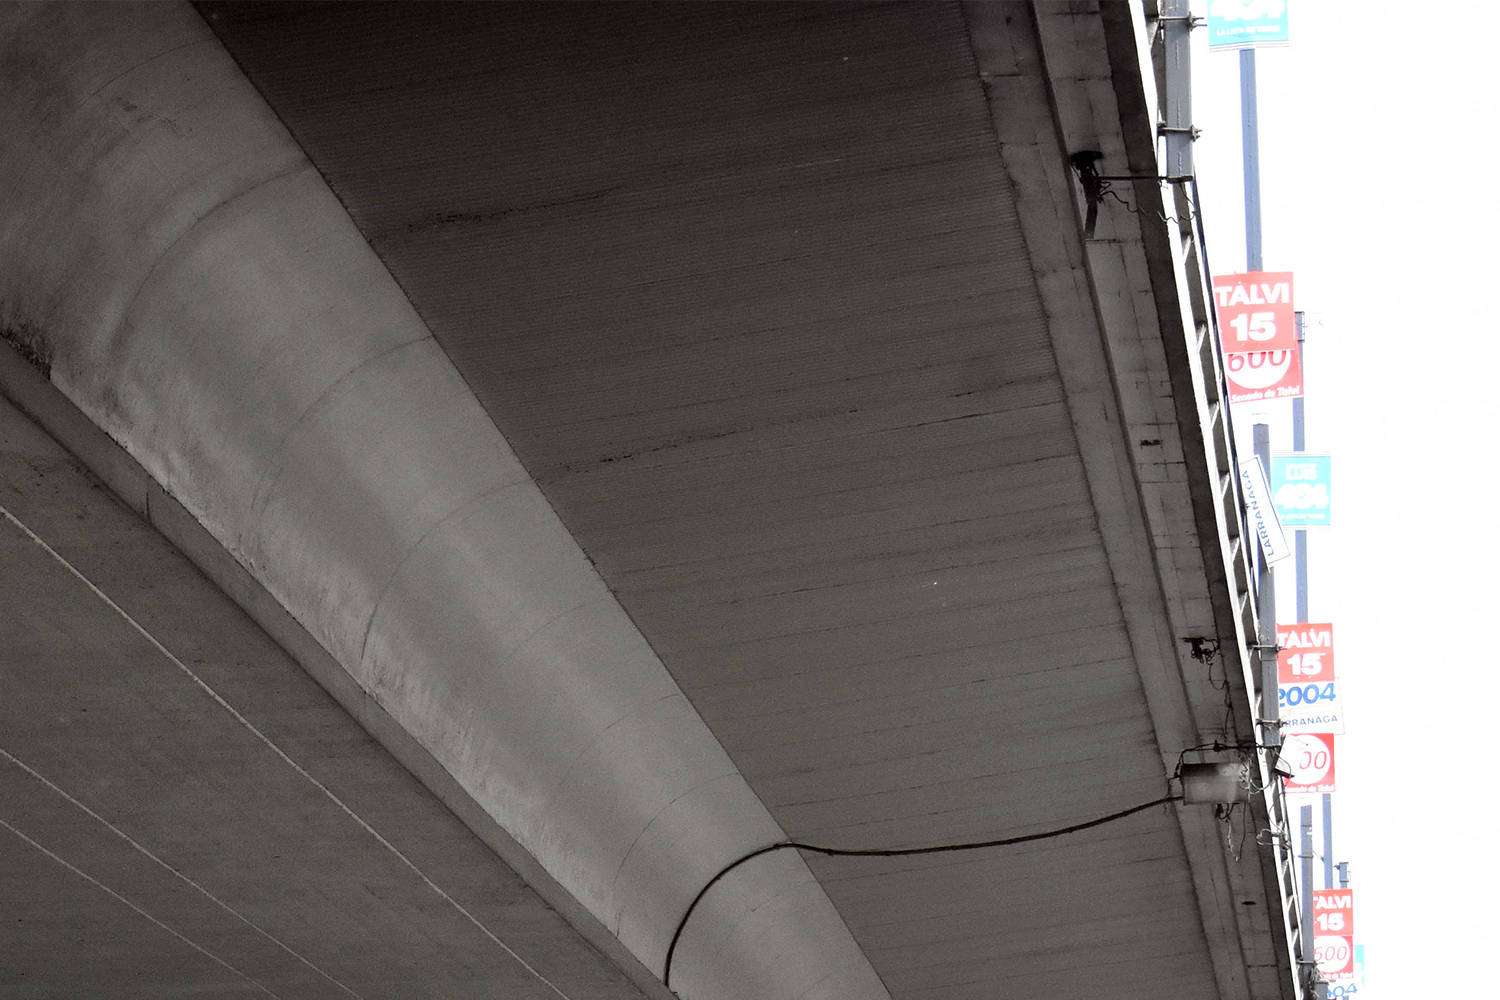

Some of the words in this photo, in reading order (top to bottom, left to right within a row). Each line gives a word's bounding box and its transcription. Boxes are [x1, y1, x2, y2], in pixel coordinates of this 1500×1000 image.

[1215, 283, 1289, 306] TALVI
[1230, 312, 1276, 341] 15
[1277, 630, 1331, 648] TALVI
[1287, 653, 1322, 675] 15
[1285, 715, 1338, 728] RRANAGA
[1299, 751, 1328, 770] 00
[1317, 913, 1344, 930] 15
